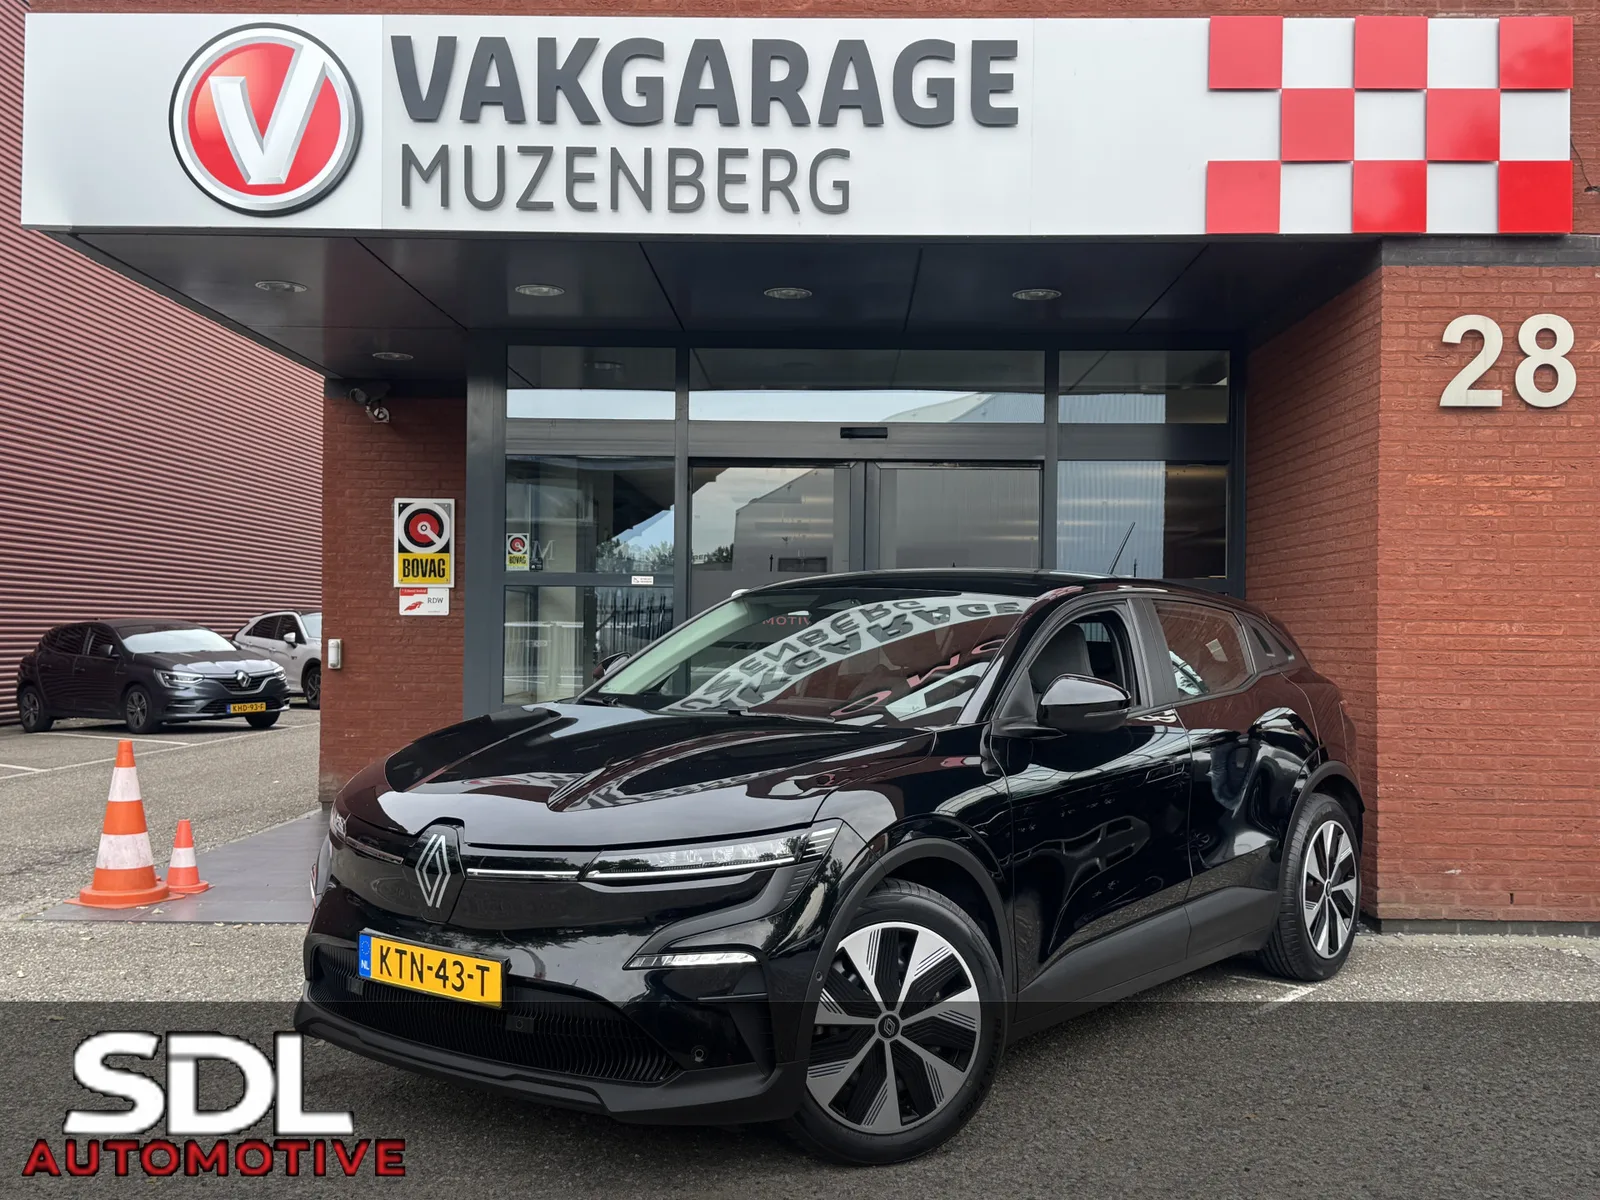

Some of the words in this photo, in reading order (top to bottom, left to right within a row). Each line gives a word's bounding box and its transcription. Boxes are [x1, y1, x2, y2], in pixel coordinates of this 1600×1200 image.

[391, 35, 1020, 128] VAKGARAGE
[401, 143, 851, 215] MUZENBERG
[1439, 313, 1577, 409] 28
[402, 557, 446, 579] BOVAG
[508, 555, 527, 565] BOVAG
[232, 703, 264, 713] KHD-93-F
[360, 959, 370, 971] NL
[379, 945, 491, 997] KTN-43-T
